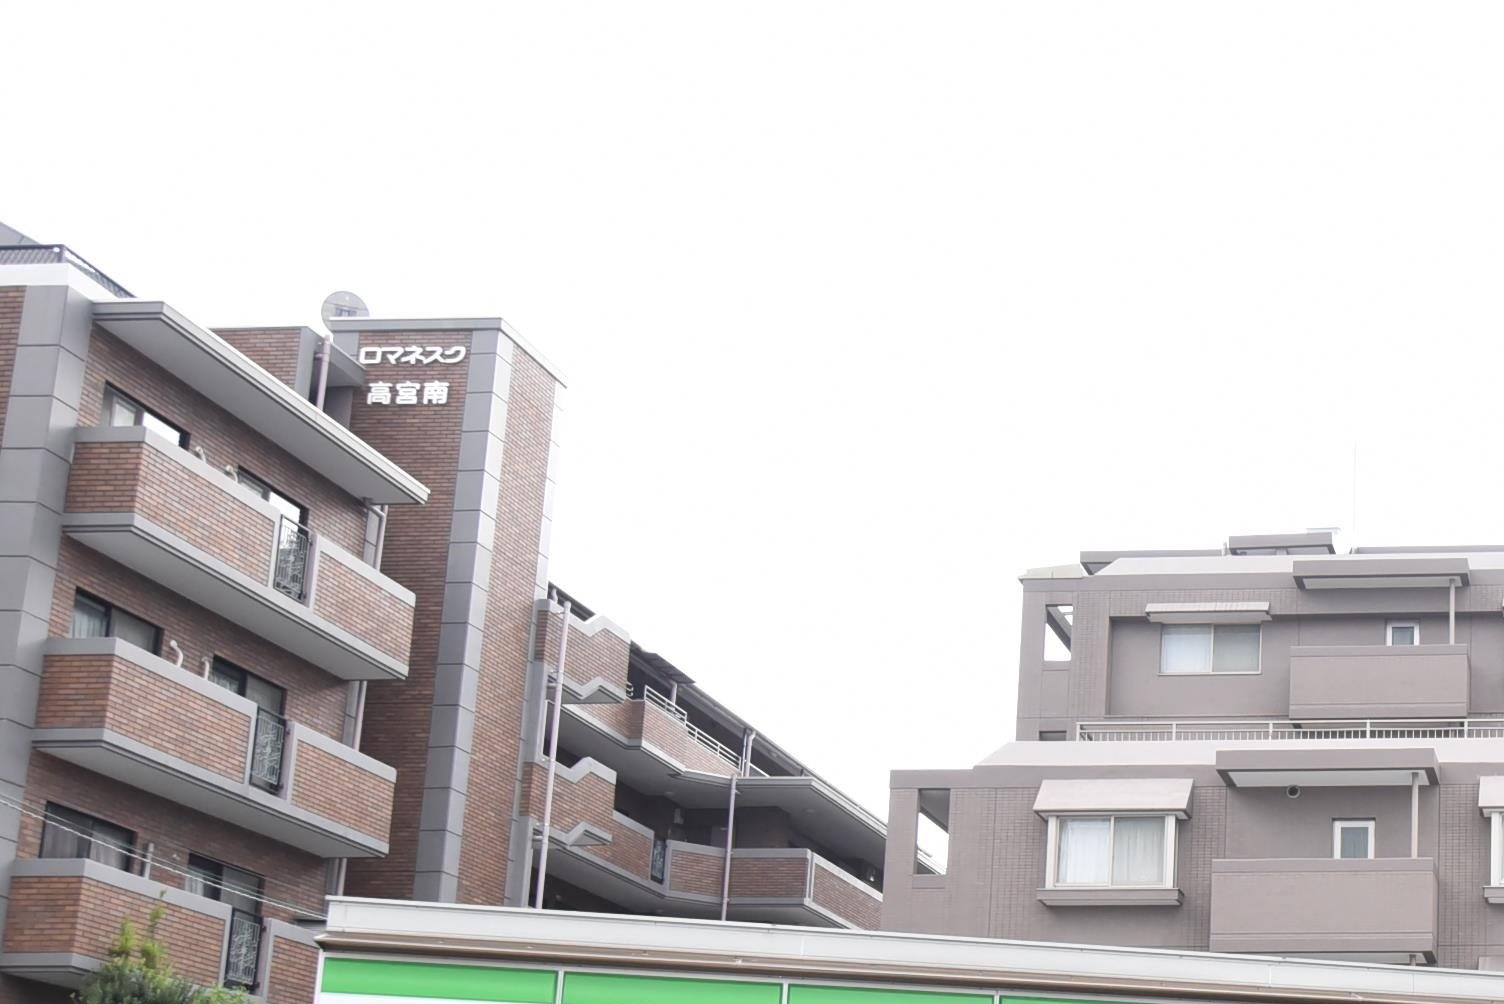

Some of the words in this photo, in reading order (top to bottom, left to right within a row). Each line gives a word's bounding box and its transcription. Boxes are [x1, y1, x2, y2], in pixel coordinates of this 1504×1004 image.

[360, 346, 466, 364] ロマネスク
[367, 381, 449, 404] 高宮南
